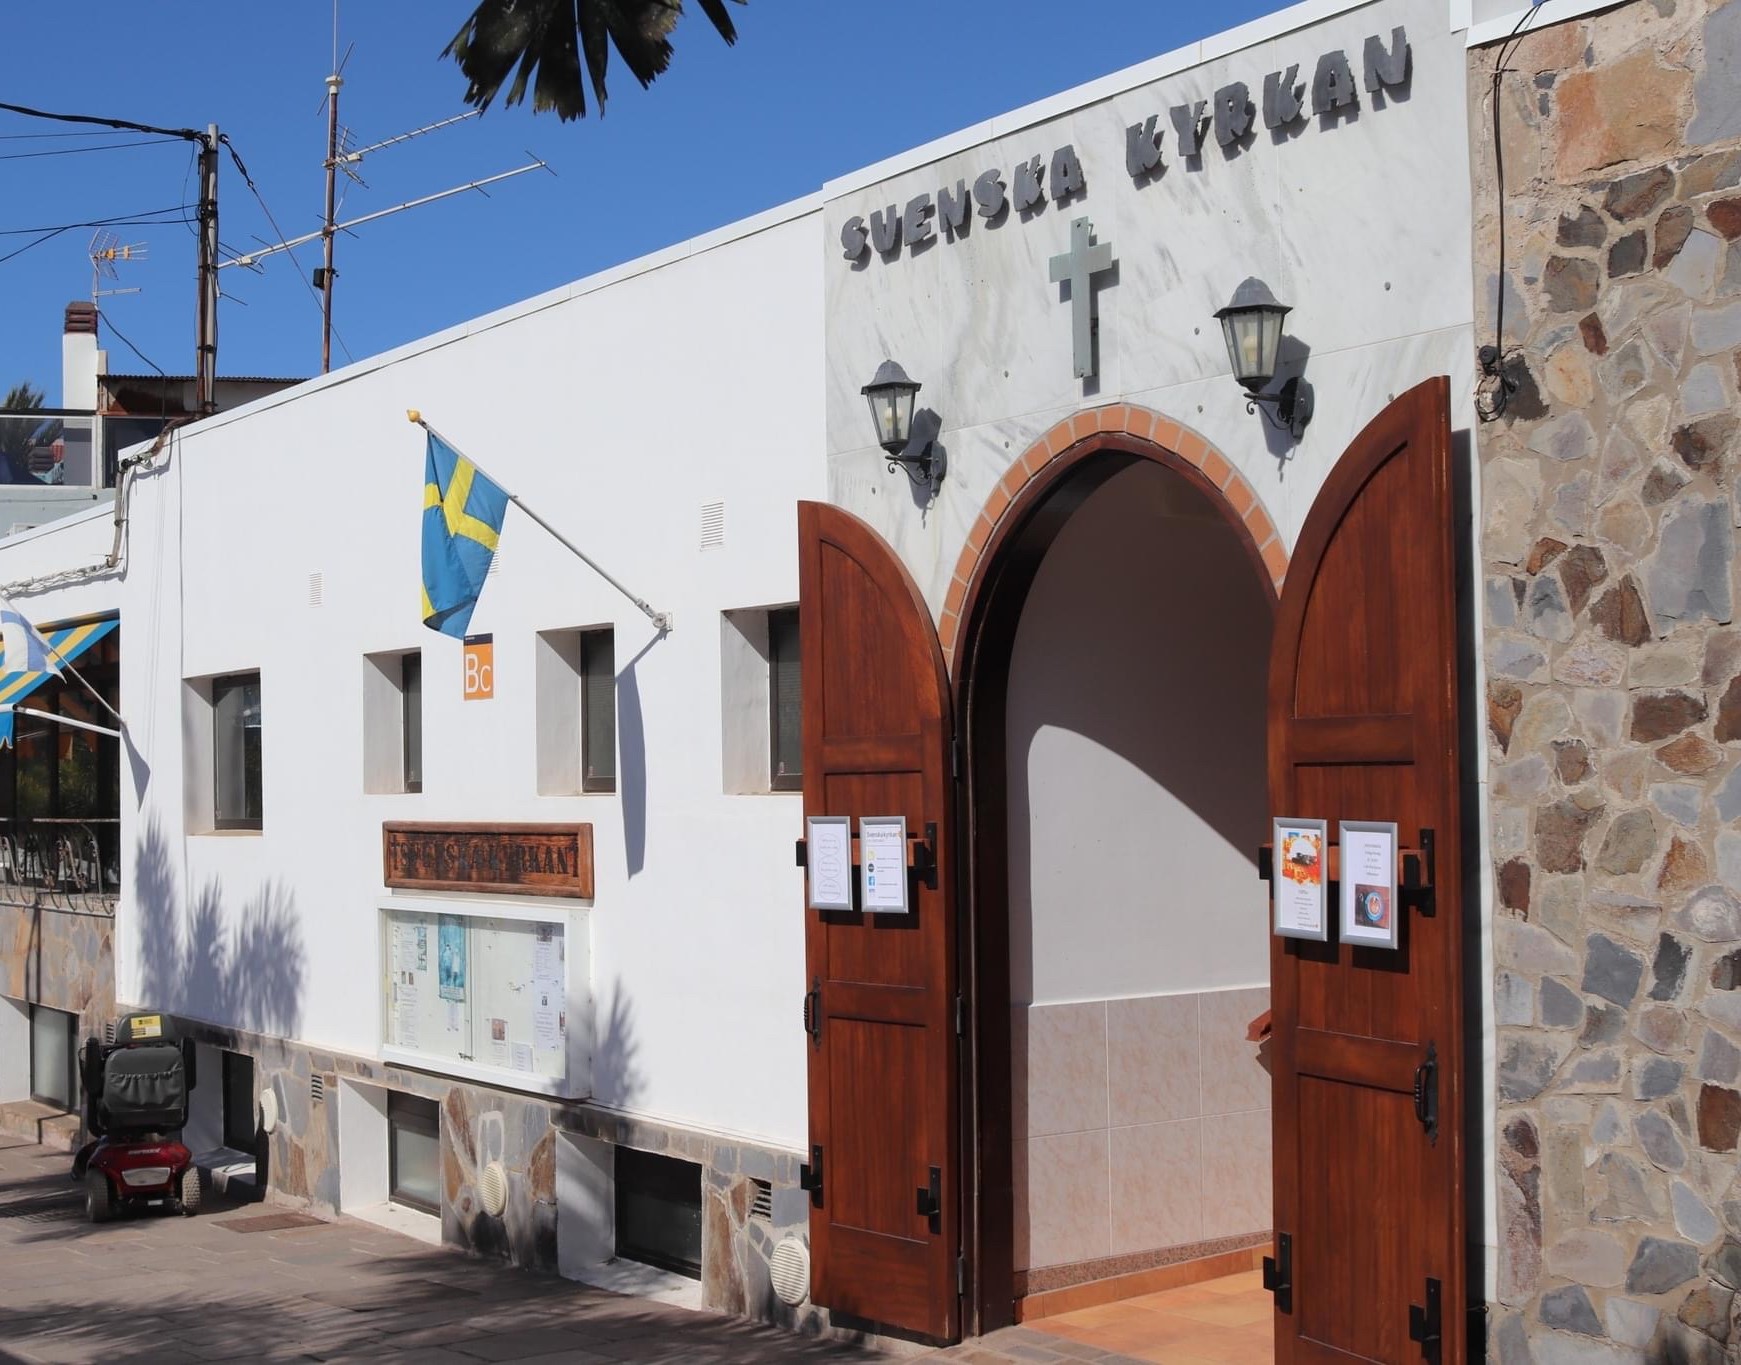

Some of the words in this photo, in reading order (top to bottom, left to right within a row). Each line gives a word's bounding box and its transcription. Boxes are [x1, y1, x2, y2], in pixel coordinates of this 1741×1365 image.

[841, 144, 1084, 260] SVENSKA
[1126, 25, 1408, 178] KYRKAN
[465, 653, 491, 693] Bc
[488, 844, 570, 875] KRKAN
